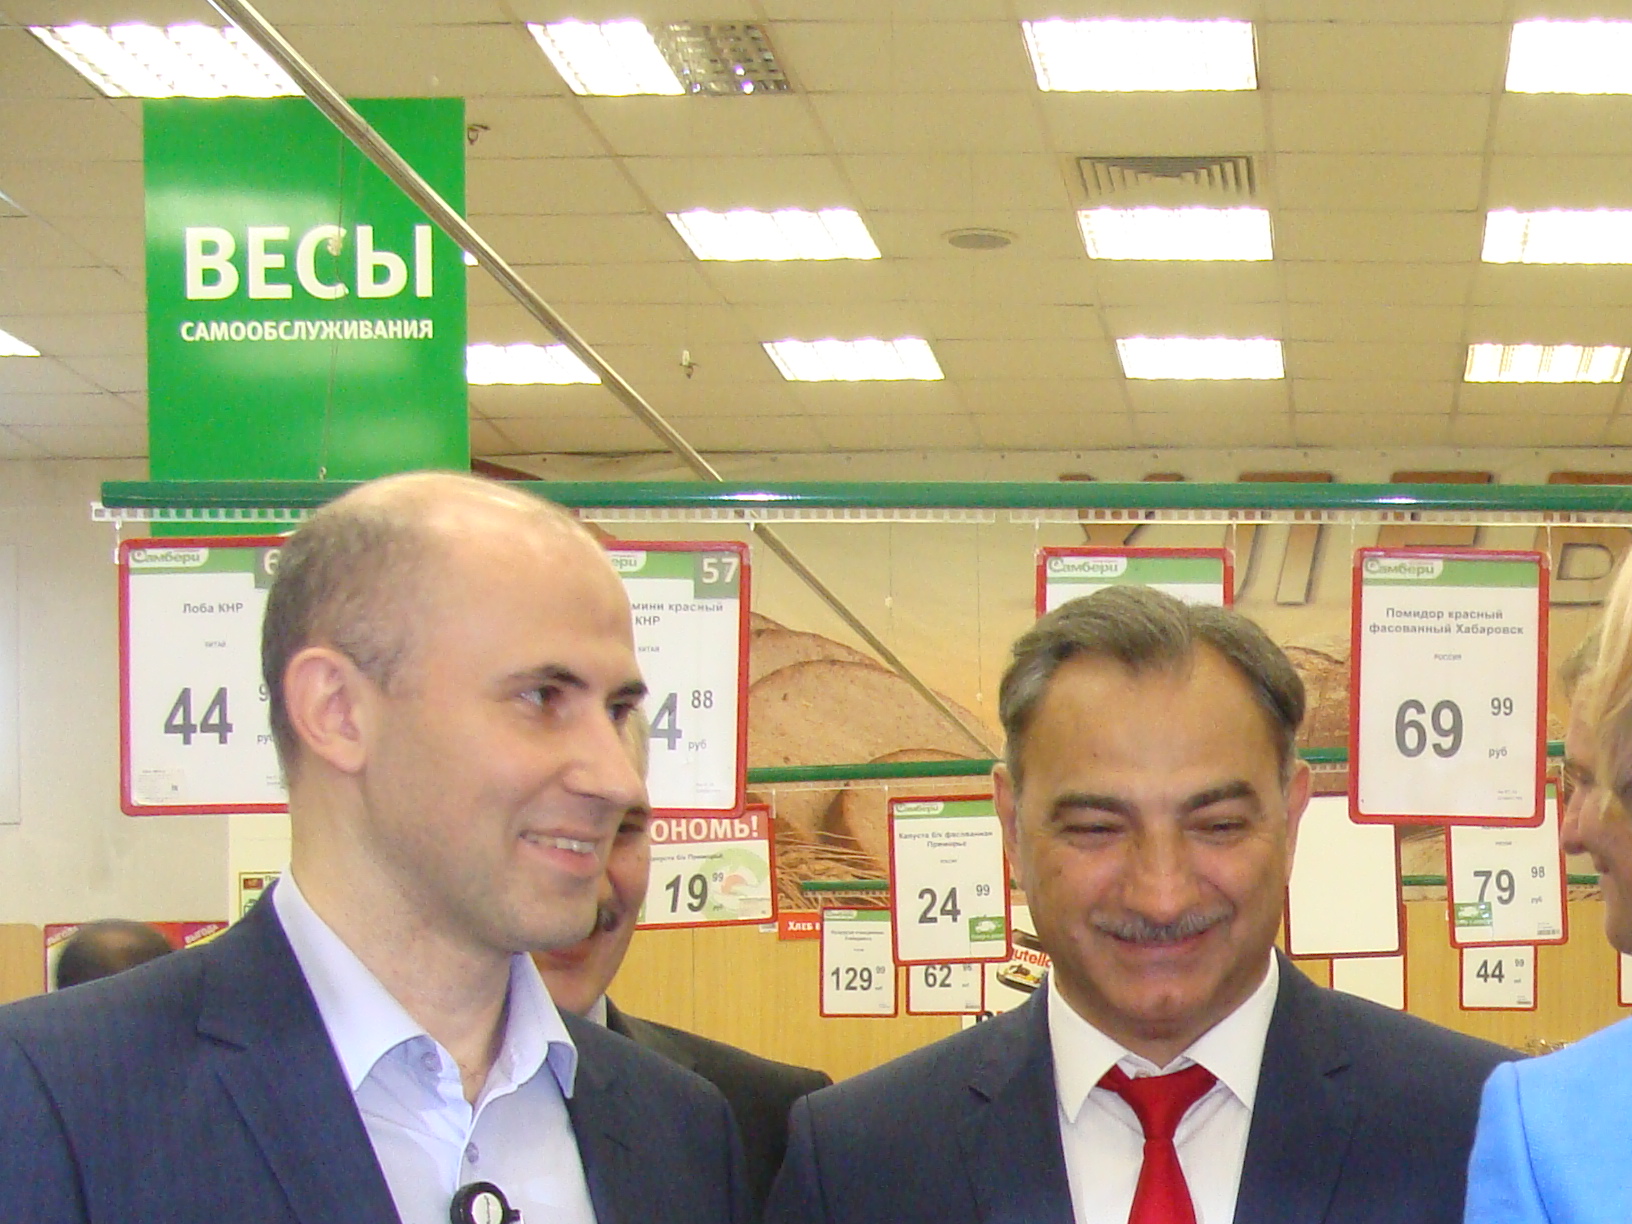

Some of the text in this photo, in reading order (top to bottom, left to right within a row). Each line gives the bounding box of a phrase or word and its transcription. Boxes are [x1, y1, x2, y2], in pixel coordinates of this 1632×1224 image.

[185, 224, 434, 300] ВЕСЫ
[180, 319, 433, 341] САМООБСЛУЖИВАНИЯ
[702, 557, 739, 584] 57
[1049, 557, 1118, 574] Самбери
[1365, 559, 1434, 577] Самбери
[182, 603, 243, 614] Лоба КНР
[632, 601, 724, 613] мини красный
[1386, 608, 1503, 621] Помидор красный
[635, 616, 660, 626] КНР
[1369, 623, 1524, 637] фасованный Хабаровск
[691, 689, 714, 709] 88
[1491, 697, 1514, 717] 99
[164, 686, 234, 745] 44
[649, 692, 683, 751] 4
[1395, 699, 1464, 759] 69
[688, 739, 707, 751] руб
[1488, 746, 1508, 759] руб
[651, 815, 759, 842] ОНОМЬ!
[712, 872, 724, 883] 99
[1530, 866, 1545, 878] 98
[665, 873, 708, 914] 19
[975, 884, 990, 897] 99
[1473, 869, 1516, 905] 79
[917, 887, 961, 924] 24
[1012, 947, 1053, 969] utella
[830, 966, 873, 991] 129
[924, 964, 953, 988] 62
[1476, 959, 1505, 983] 44
